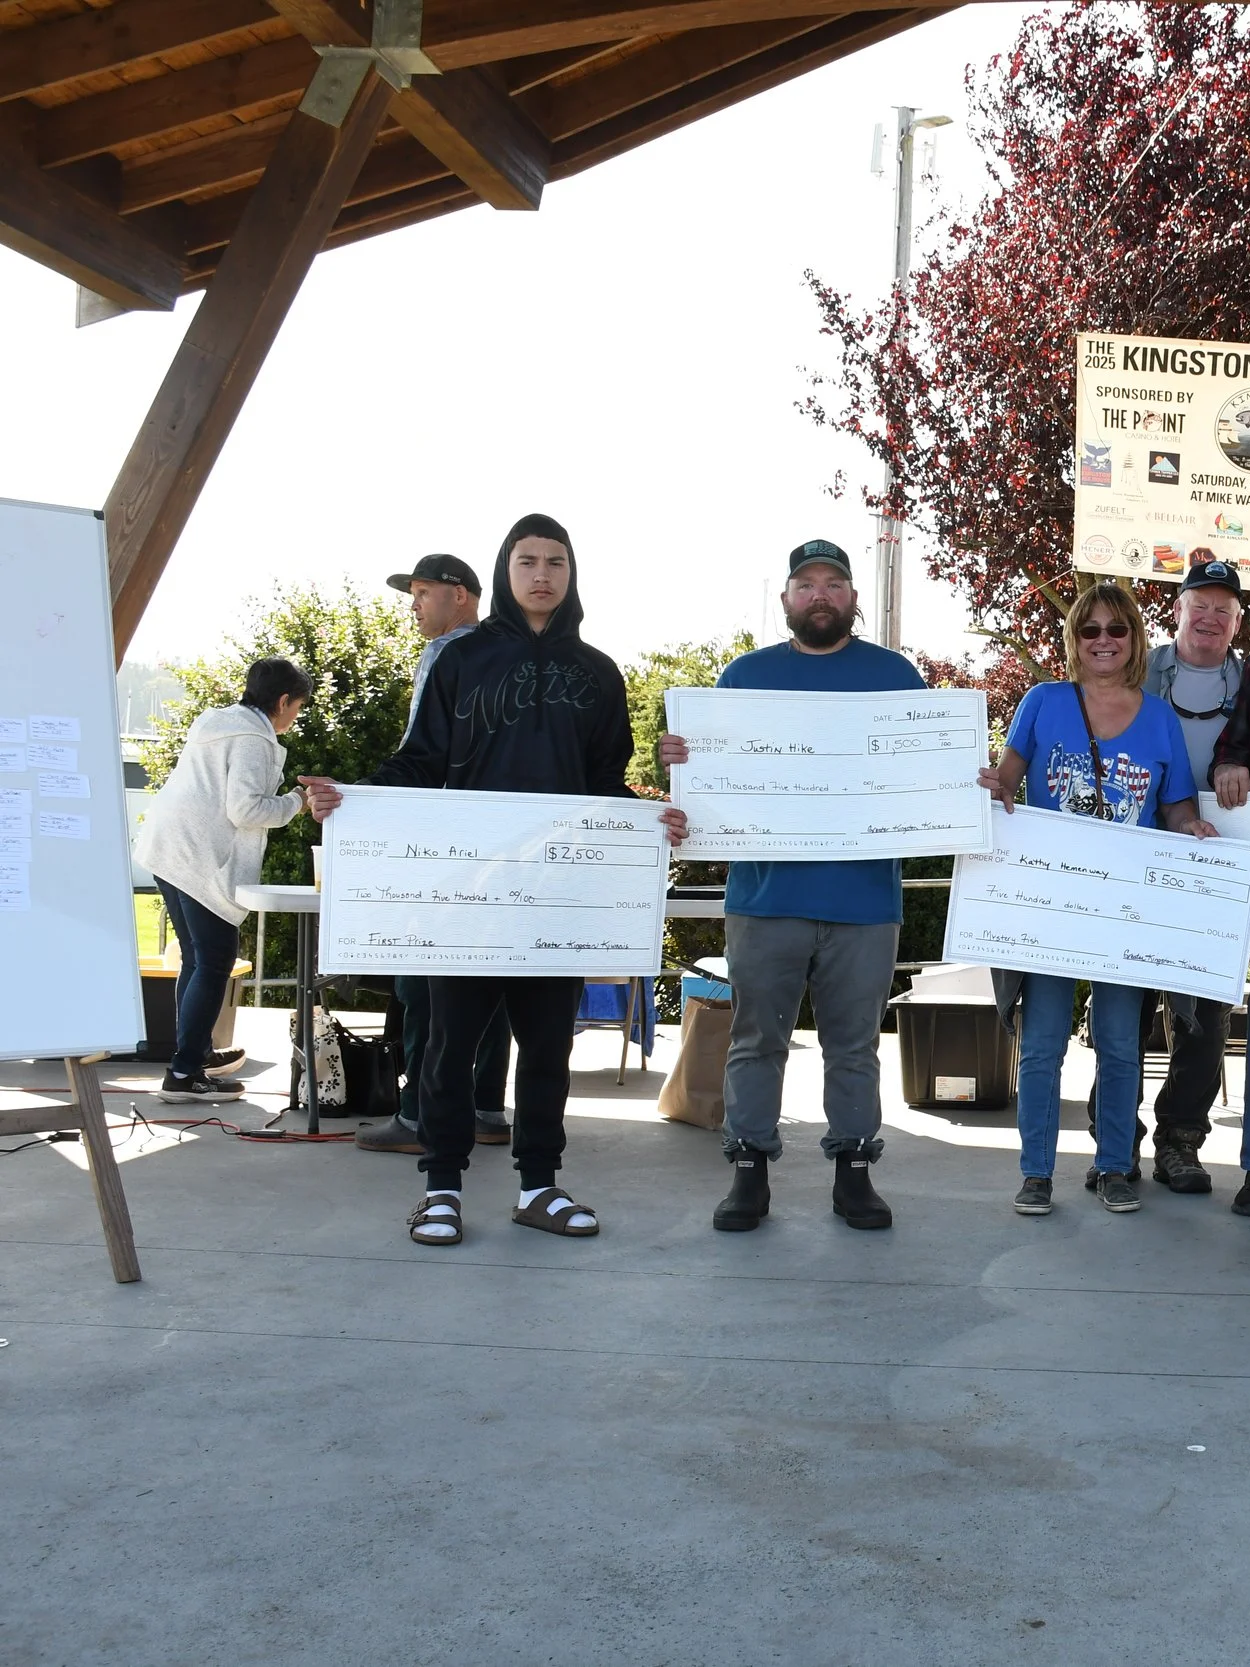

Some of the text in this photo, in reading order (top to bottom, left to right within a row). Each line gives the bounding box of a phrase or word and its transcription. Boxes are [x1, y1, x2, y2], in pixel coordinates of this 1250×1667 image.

[1086, 340, 1115, 355] THE
[1085, 355, 1116, 370] 2025
[1096, 385, 1194, 404] SPONSORED BY
[1102, 408, 1127, 429] THE
[1125, 432, 1152, 441] CASINO
[1161, 435, 1182, 443] HOTEL
[1191, 473, 1247, 489] SATURDAY,
[1190, 490, 1203, 502] AT
[1206, 492, 1232, 504] MIKE
[1094, 504, 1126, 515] ZUFELT
[1155, 512, 1196, 524] BELFAIR
[1081, 545, 1116, 555] HENERY
[740, 740, 782, 754] Justin
[789, 743, 815, 754] Hike
[691, 776, 713, 790] One
[714, 777, 765, 791] Thousand
[769, 781, 788, 791] Five
[794, 782, 829, 792] Hundred
[405, 844, 438, 858] Niko
[449, 845, 477, 858] Ariel
[969, 854, 993, 862] ORDER
[1020, 854, 1050, 870] Kathy
[348, 887, 371, 899] Two
[375, 886, 422, 900] Thousand
[432, 890, 449, 901] Five
[454, 890, 487, 901] Hundred
[986, 885, 1008, 899] Five
[1016, 890, 1051, 905] Hundred
[1207, 929, 1239, 940] DOLLARS
[404, 934, 436, 946] Prize
